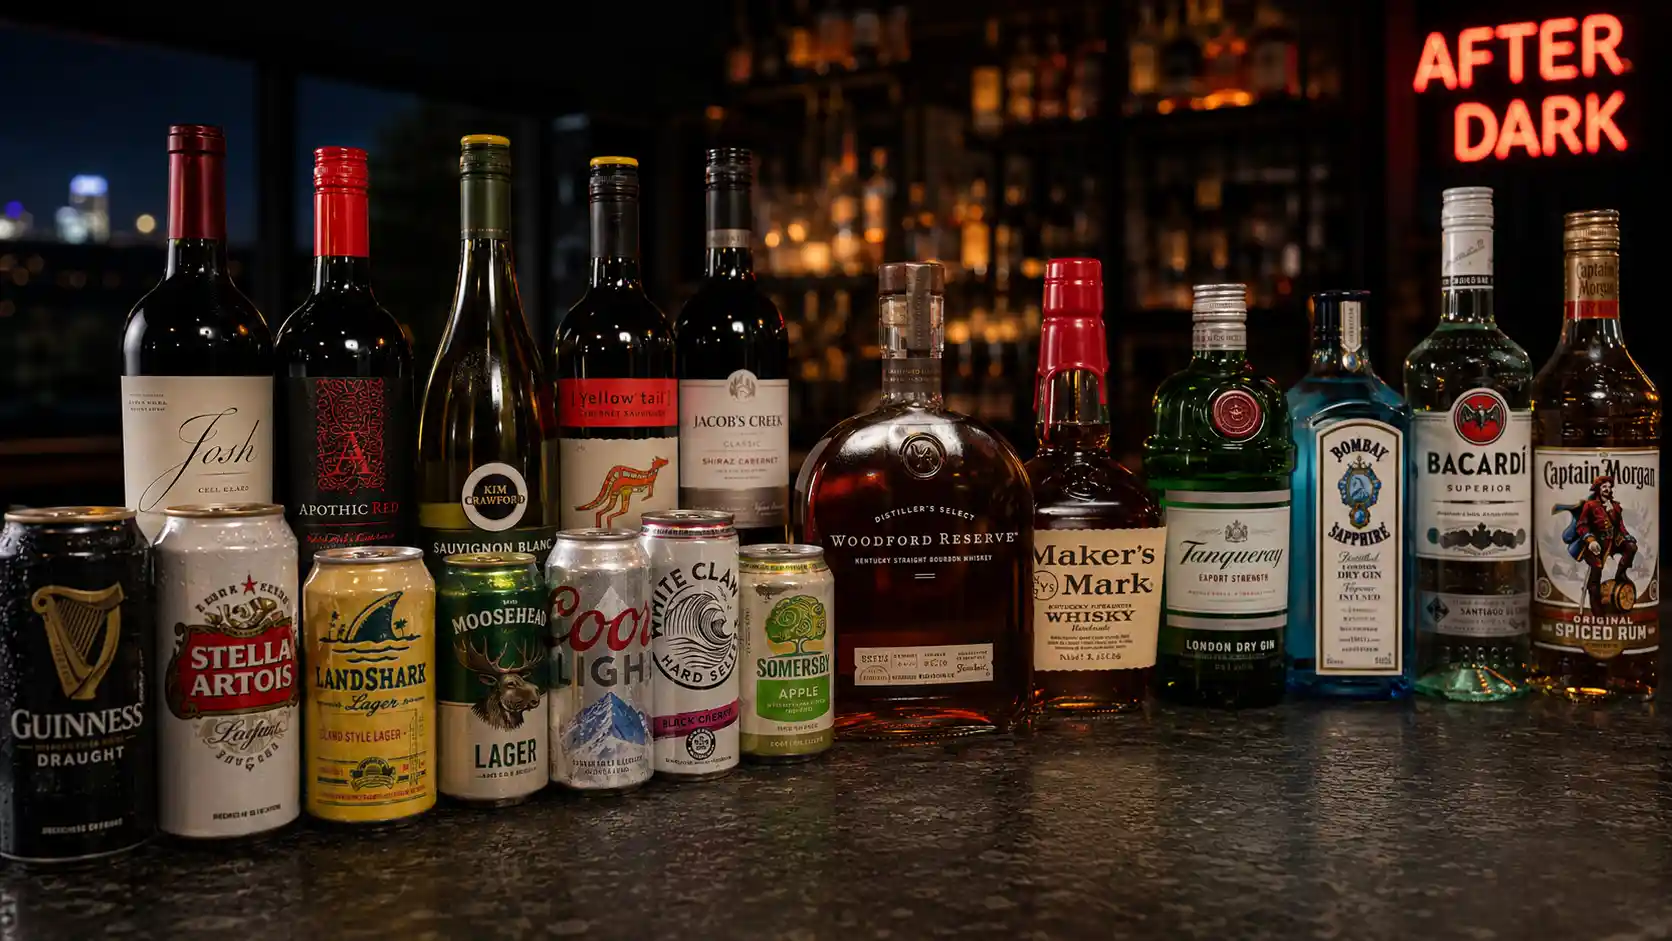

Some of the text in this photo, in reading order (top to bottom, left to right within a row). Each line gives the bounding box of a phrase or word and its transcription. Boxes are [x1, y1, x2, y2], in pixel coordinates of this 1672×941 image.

[1413, 13, 1624, 93] AFTER
[1455, 90, 1628, 162] DARK
[693, 415, 783, 429] JACOB'S CREEK
[139, 407, 260, 513] Josh
[1330, 438, 1389, 462] BOMBAY
[1427, 446, 1526, 476] BACARDÍ
[702, 458, 735, 466] SHIRAZ
[1544, 459, 1655, 489] Captain Morgan
[465, 495, 525, 505] CRAWFORD
[483, 484, 507, 494] KIM
[1447, 484, 1511, 493] SUPERIOR
[298, 501, 399, 517] APOTHIC RED
[875, 505, 976, 523] DISTILLER'S SELECT
[830, 532, 1015, 547] WOODFORD RESERVE
[1328, 522, 1391, 546] SAPPHIRE
[434, 539, 552, 554] SAUVIGNON BLANC
[1033, 544, 1155, 566] Maker's
[1179, 540, 1284, 570] Tanqueray
[1062, 573, 1152, 595] Mark
[1337, 571, 1382, 579] DRY GIN
[452, 607, 547, 635] MOOSEHEAD
[1044, 610, 1137, 623] WHISKY
[1573, 615, 1633, 626] ORIGINAL
[1555, 622, 1647, 641] SPICED RUM
[191, 642, 293, 669] STELLA
[1186, 638, 1275, 653] LONDON DRY GIN
[315, 663, 427, 691] LANDSHARK
[558, 652, 651, 687] LIGH
[661, 655, 703, 682] HARD
[756, 654, 830, 679] SOMERSBY
[191, 663, 293, 697] ARTOIS
[779, 686, 819, 699] APPLE
[345, 693, 399, 717] Lager
[11, 702, 144, 739] GUINNESS
[374, 729, 400, 742] LAGER
[37, 745, 124, 768] DRAUGHT
[475, 738, 537, 769] LAGER
